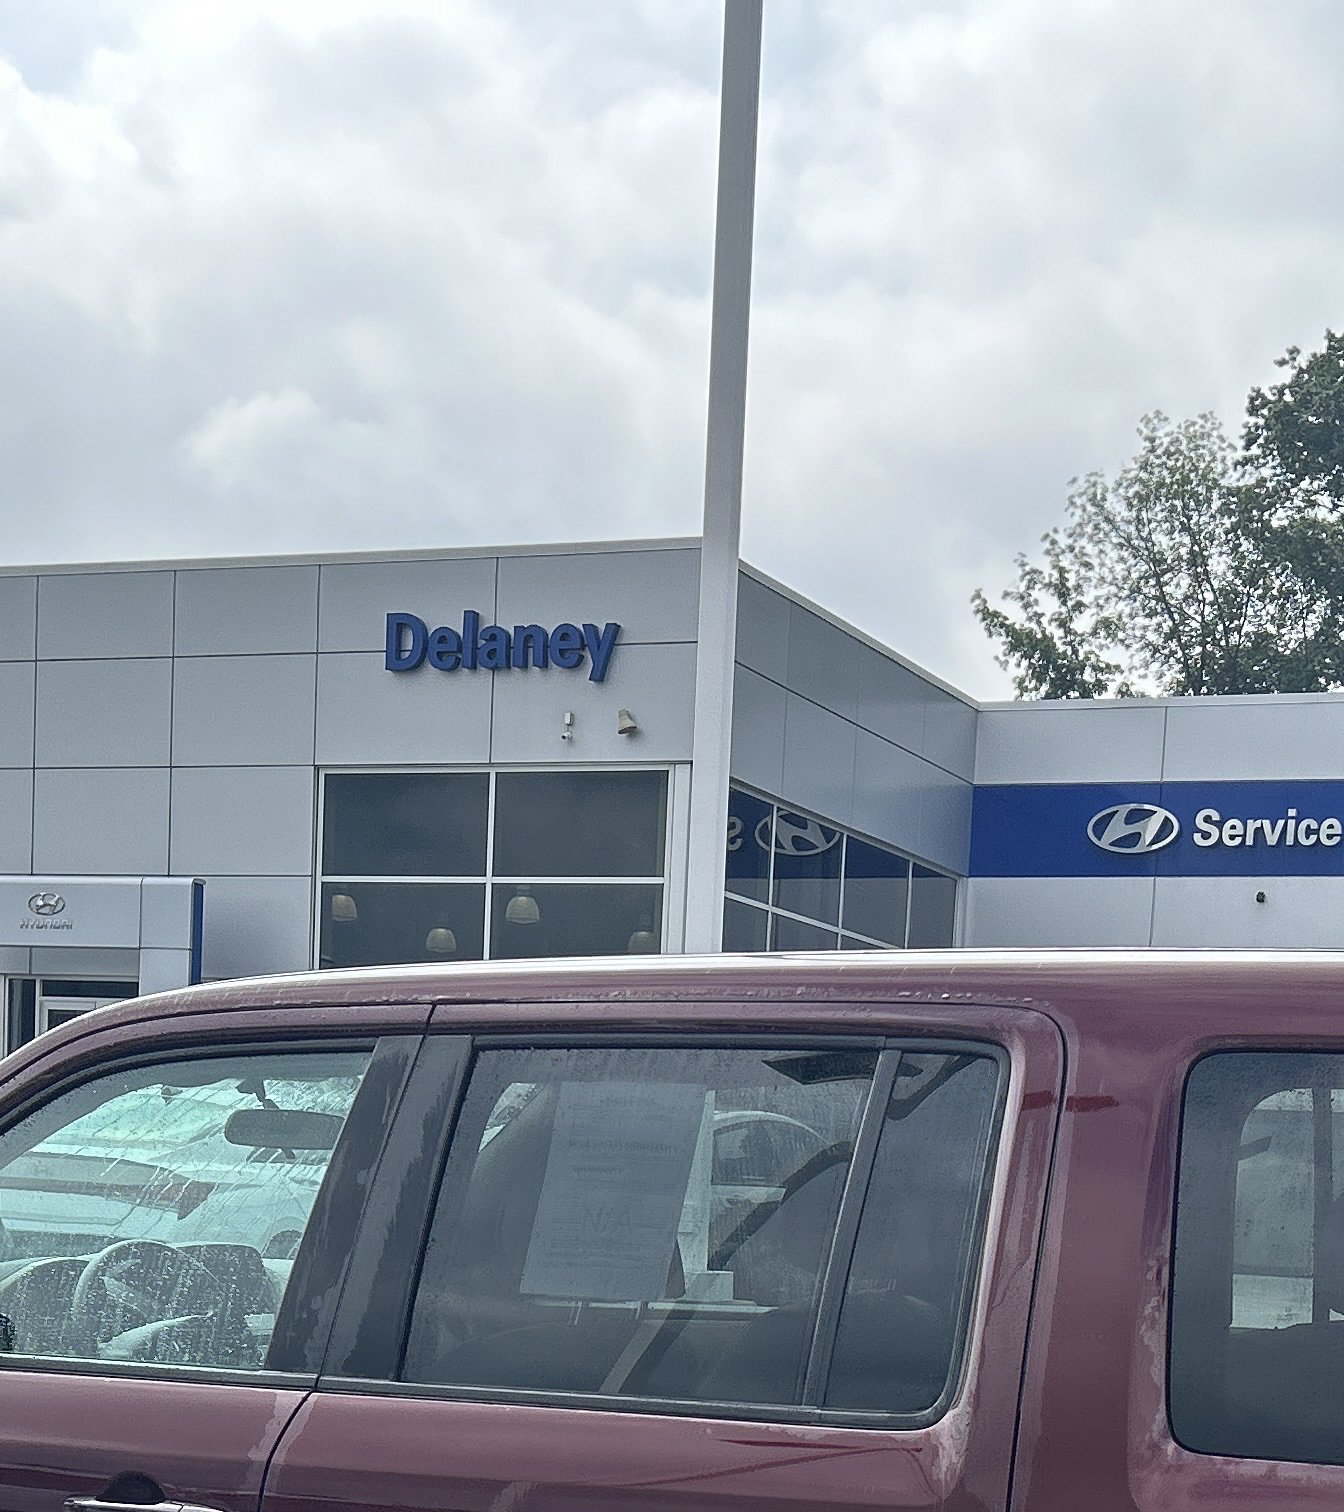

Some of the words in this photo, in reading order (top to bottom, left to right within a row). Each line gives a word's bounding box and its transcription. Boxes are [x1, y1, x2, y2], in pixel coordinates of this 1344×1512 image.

[385, 610, 620, 681] Delaney
[1193, 808, 1343, 847] Service
[19, 919, 73, 930] HYUNDAI
